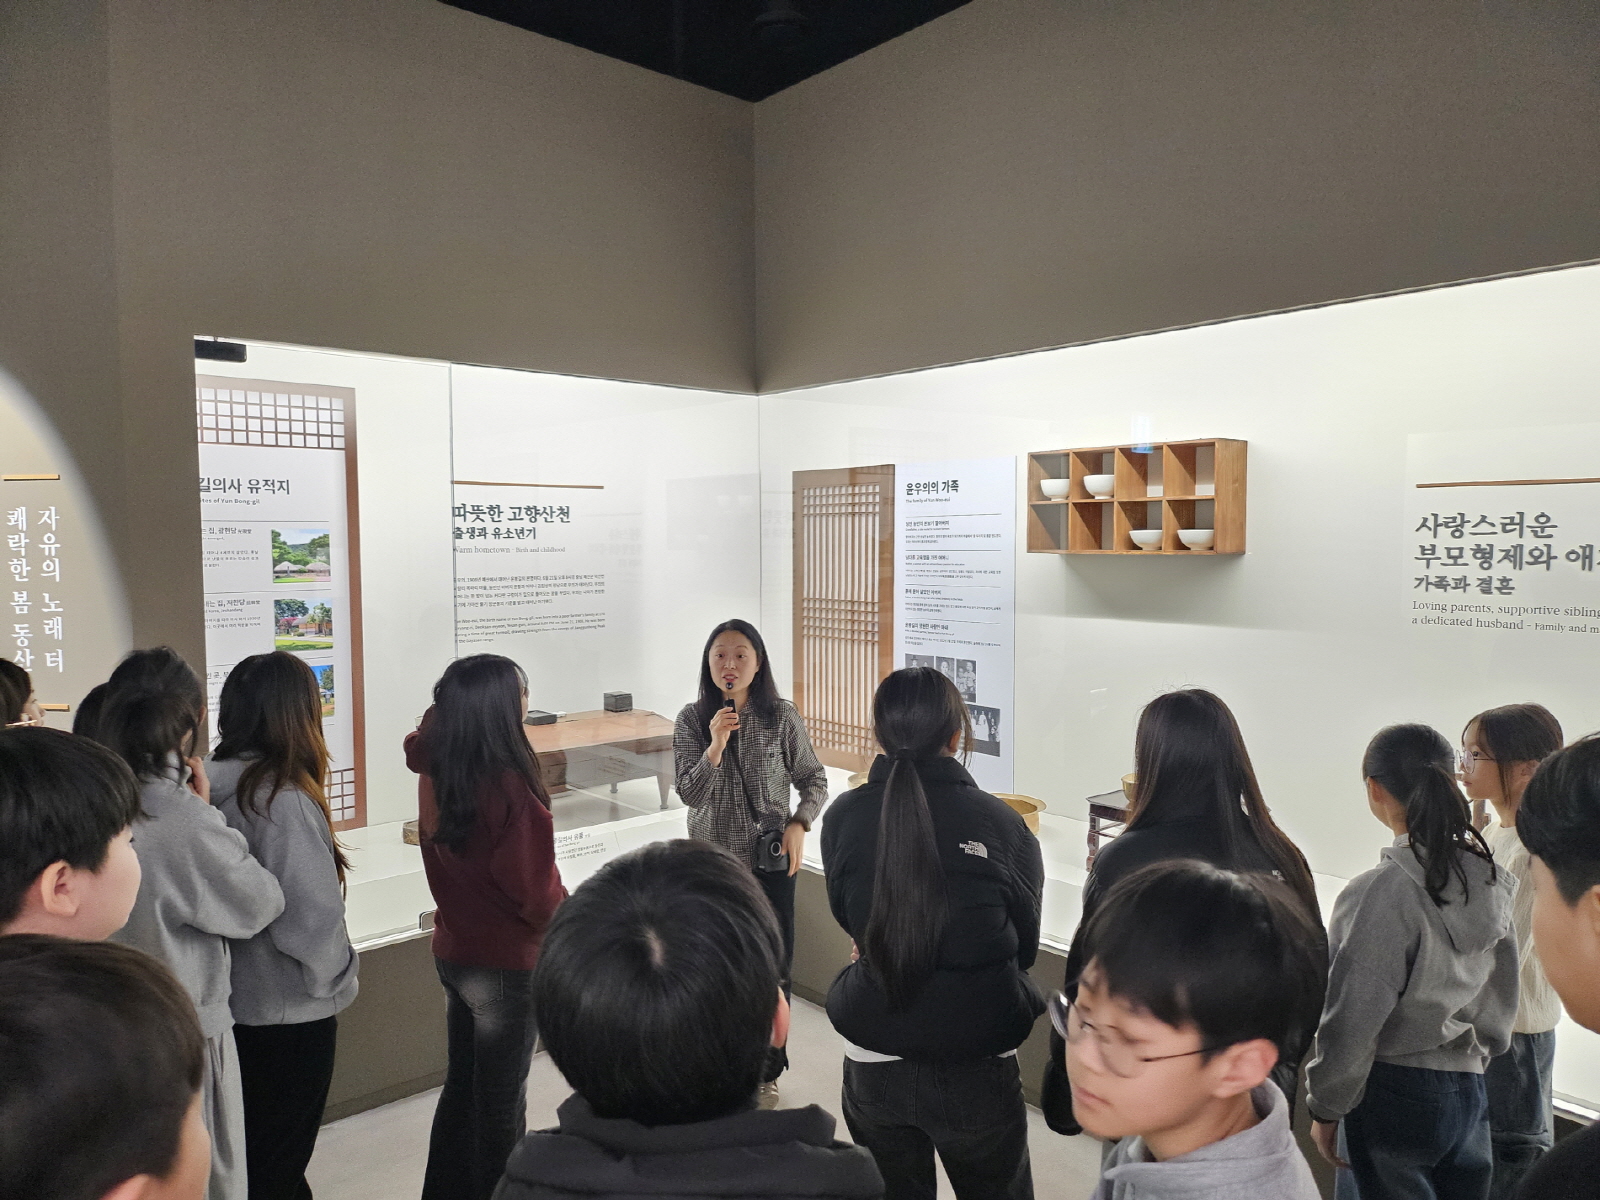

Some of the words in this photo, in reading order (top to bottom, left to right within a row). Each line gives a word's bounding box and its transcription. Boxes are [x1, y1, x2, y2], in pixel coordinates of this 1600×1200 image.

[200, 478, 242, 493] 길의사
[247, 479, 290, 495] 유적지
[906, 481, 939, 495] 윤우의의
[942, 480, 959, 493] 가족
[452, 503, 504, 523] 따뜻한
[507, 505, 570, 523] 고향산천
[1415, 511, 1558, 539] 사랑스러운
[7, 506, 31, 582] 쾌락한
[38, 506, 61, 582] 자유의
[452, 527, 489, 539] 출생과
[491, 527, 536, 539] 유소년기
[1414, 544, 1558, 572] 부모형제와
[1565, 544, 1600, 572] 애
[1414, 575, 1471, 593] 가족과
[1475, 576, 1515, 595] 결혼
[10, 591, 32, 615] 봄
[1412, 601, 1447, 613] Loving
[1450, 602, 1494, 614] parents,
[1497, 604, 1560, 617] supportive
[41, 593, 63, 641] 노래
[1420, 615, 1473, 627] dedicated
[1476, 618, 1524, 630] husband
[1534, 622, 1566, 633] Family
[1568, 624, 1587, 633] and
[11, 623, 35, 672] 동산
[44, 649, 63, 673] 터
